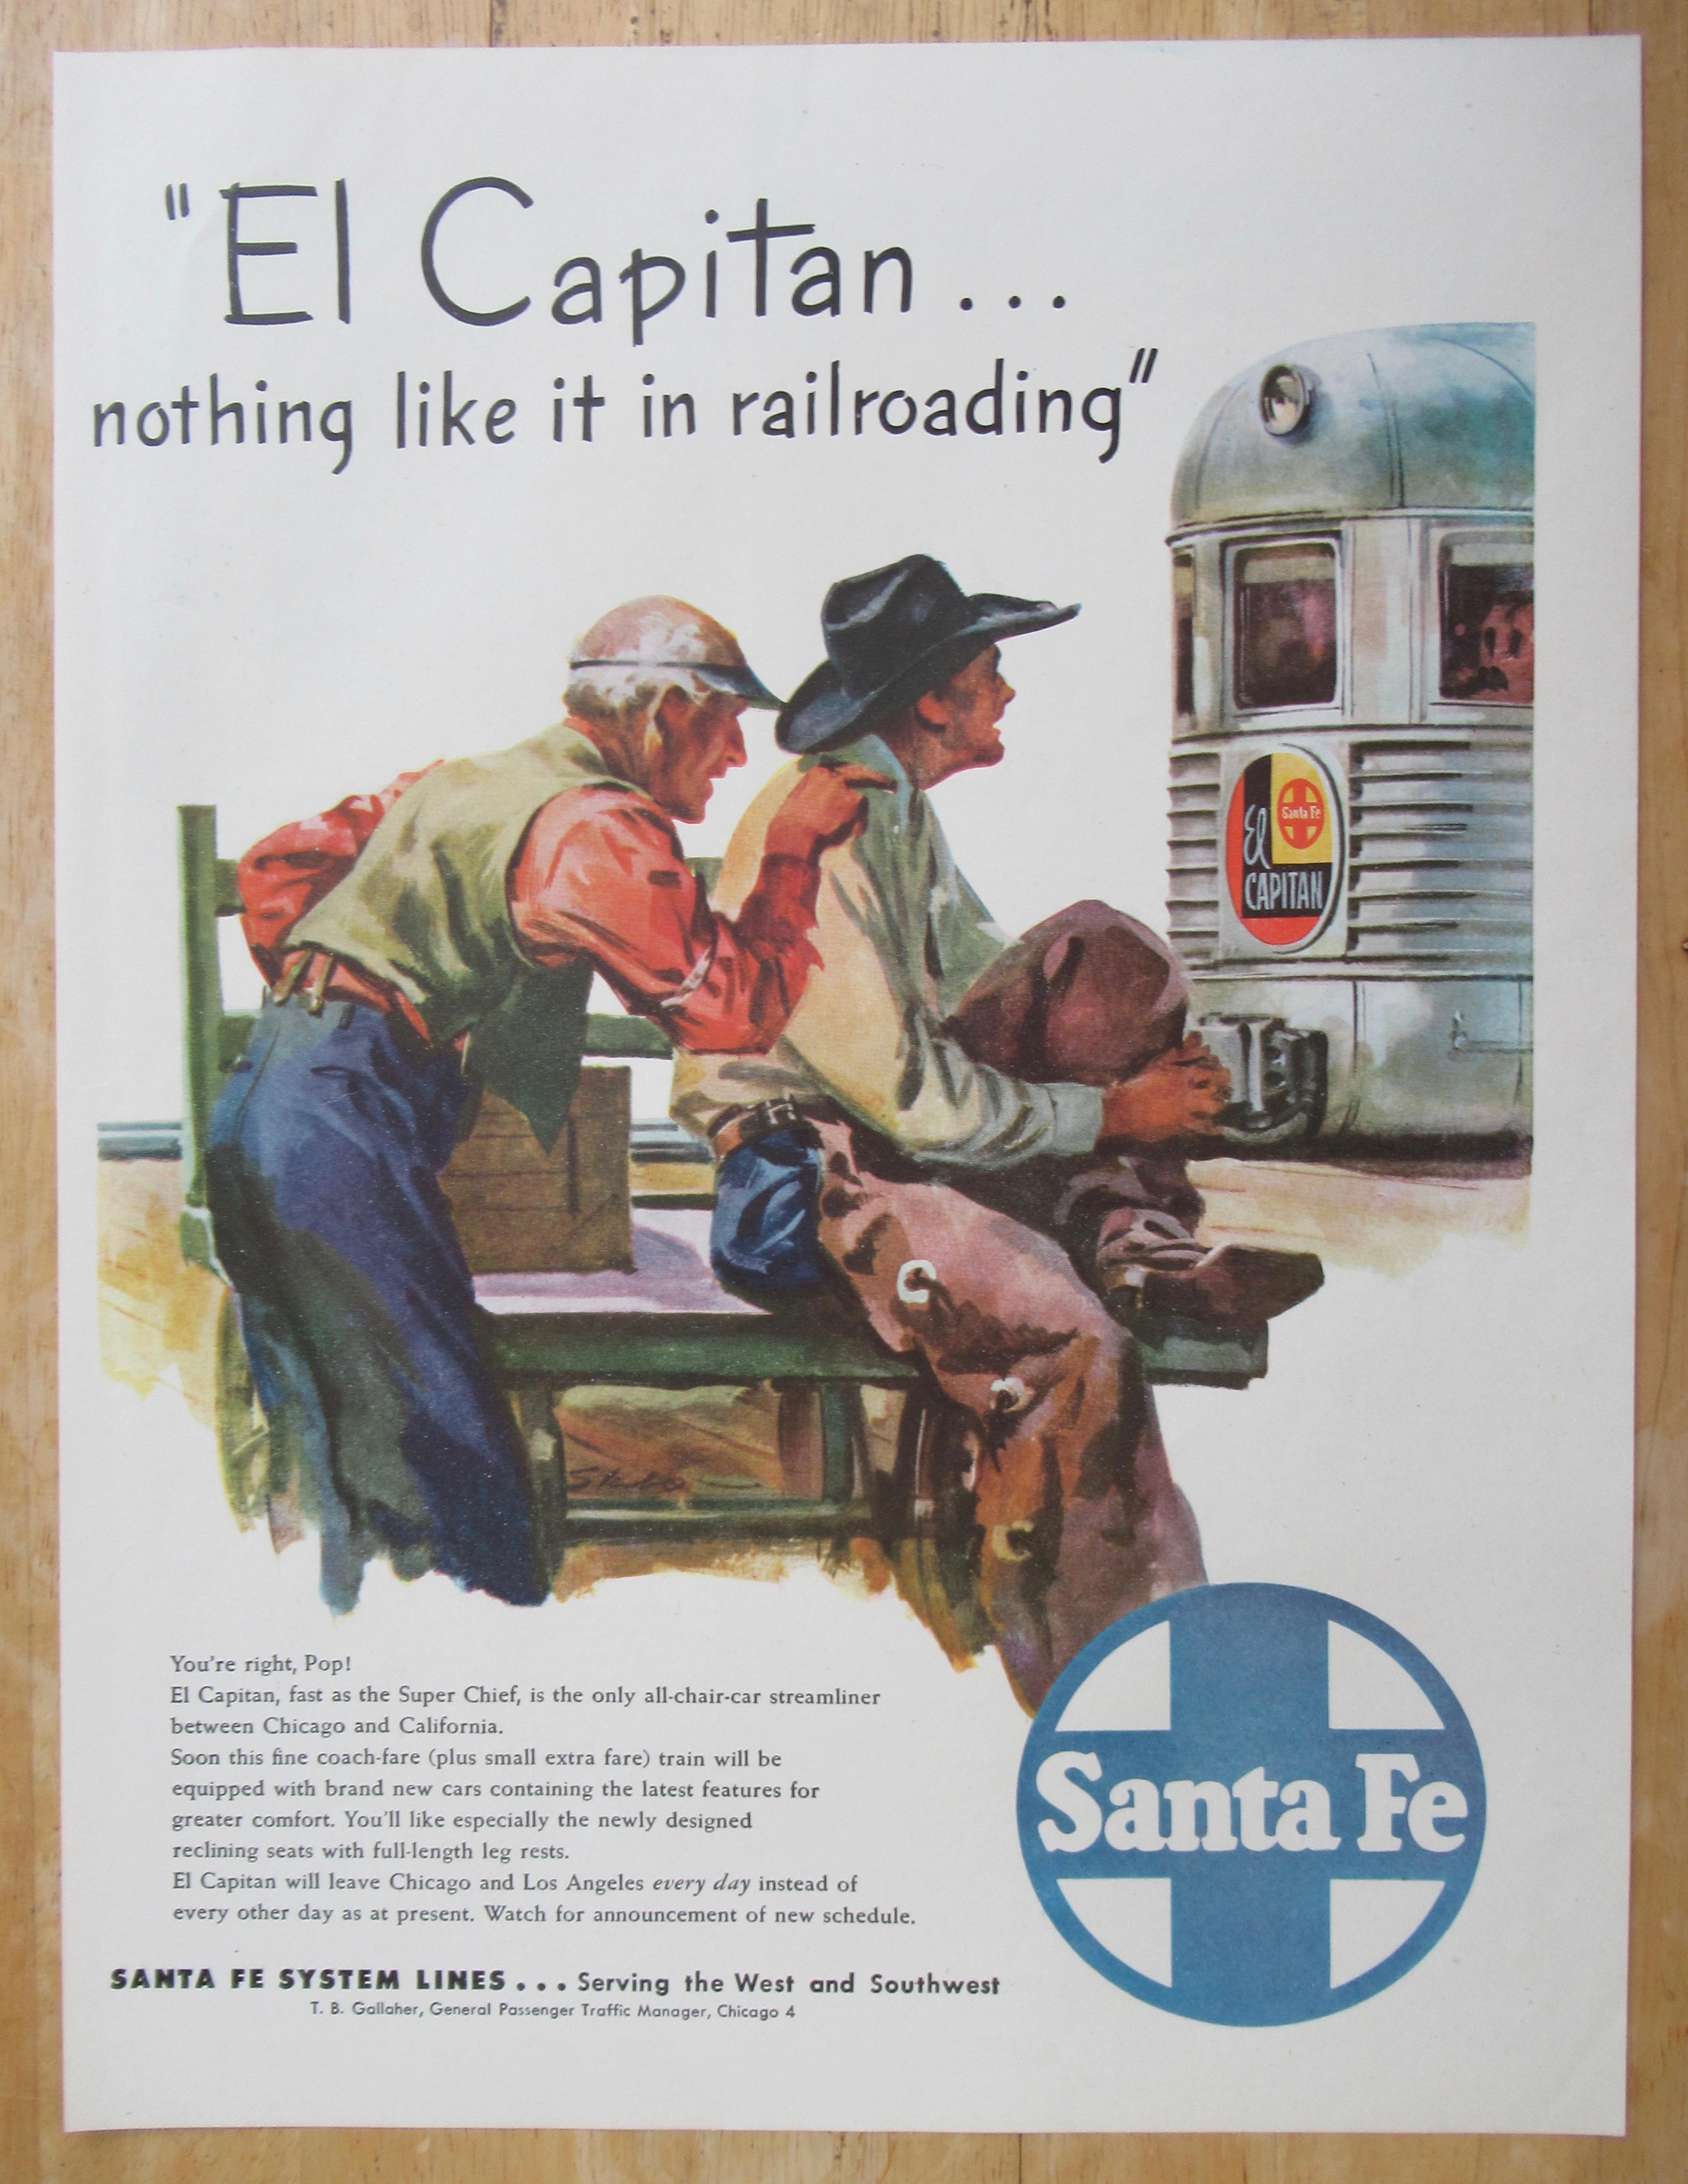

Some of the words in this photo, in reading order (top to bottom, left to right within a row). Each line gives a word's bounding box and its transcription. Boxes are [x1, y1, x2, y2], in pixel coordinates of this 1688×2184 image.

[164, 176, 351, 325] "El
[420, 175, 913, 347] Capitan
[94, 372, 353, 476] nothing
[396, 369, 516, 449] like
[552, 374, 606, 443] it
[642, 373, 697, 439] in
[732, 348, 1159, 464] railroading"
[1281, 806, 1308, 819] Santa
[1310, 805, 1321, 819] Fe
[1244, 804, 1271, 869] El
[1245, 871, 1322, 911] CAPITAN
[169, 1655, 236, 1673] You're
[245, 1654, 297, 1677] right,
[304, 1654, 351, 1676] Pop!
[170, 1686, 190, 1704] El
[197, 1685, 280, 1708] Capitan,
[289, 1684, 323, 1702] fast
[331, 1691, 351, 1702] as
[358, 1685, 390, 1702] the
[399, 1685, 456, 1708] Super
[463, 1685, 521, 1706] Chief,
[530, 1687, 545, 1703] is
[552, 1685, 583, 1703] the
[591, 1685, 636, 1708] only
[644, 1686, 762, 1704] all-chair-car
[769, 1687, 881, 1705] streamliner
[170, 1716, 254, 1734] between
[262, 1716, 346, 1739] Chicago
[354, 1716, 391, 1733] and
[399, 1716, 503, 1734] California.
[171, 1748, 220, 1766] Soon
[229, 1748, 264, 1765] this
[271, 1747, 308, 1765] fine
[317, 1747, 420, 1765] coach-fare
[428, 1748, 476, 1770] (plus
[484, 1748, 536, 1765] small
[545, 1751, 595, 1765] extra
[604, 1748, 650, 1768] fare)
[658, 1751, 705, 1766] train
[713, 1749, 749, 1767] will
[758, 1749, 782, 1767] be
[172, 1779, 265, 1801] equipped
[273, 1779, 316, 1797] with
[325, 1778, 385, 1797] brand
[392, 1784, 434, 1796] new
[442, 1784, 482, 1797] cars
[490, 1781, 594, 1801] containing
[601, 1779, 633, 1797] the
[642, 1780, 694, 1798] latest
[702, 1779, 782, 1798] features
[789, 1780, 820, 1799] for
[1036, 1750, 1341, 1853] Santa
[1355, 1752, 1468, 1853] Fe
[171, 1814, 243, 1832] greater
[252, 1810, 335, 1828] comfort.
[344, 1810, 400, 1828] You'll
[409, 1810, 445, 1828] like
[452, 1810, 549, 1833] especially
[557, 1810, 589, 1827] the
[598, 1810, 657, 1832] newly
[665, 1811, 753, 1833] designed
[172, 1840, 259, 1863] reclining
[266, 1845, 314, 1859] seats
[321, 1841, 365, 1859] with
[373, 1840, 474, 1864] full-length
[482, 1841, 512, 1864] leg
[520, 1845, 569, 1859] rests.
[172, 1871, 191, 1889] El
[200, 1872, 277, 1894] Capitan
[284, 1872, 320, 1889] will
[328, 1872, 380, 1890] leave
[389, 1872, 471, 1895] Chicago
[480, 1873, 515, 1891] and
[523, 1873, 557, 1891] Los
[565, 1873, 644, 1896] Angeles
[652, 1879, 706, 1897] every
[713, 1873, 751, 1897] day
[759, 1874, 829, 1892] instead
[836, 1874, 858, 1893] of
[172, 1908, 229, 1924] every
[237, 1903, 290, 1921] other
[298, 1903, 334, 1925] day
[342, 1909, 362, 1921] as
[369, 1907, 388, 1921] at
[396, 1907, 474, 1926] present.
[483, 1905, 547, 1922] Watch
[556, 1904, 585, 1922] for
[593, 1908, 737, 1922] announcement
[746, 1905, 767, 1923] of
[774, 1911, 815, 1923] new
[823, 1905, 916, 1925] schedule.
[110, 1968, 216, 1990] SANTA
[230, 1968, 264, 1989] FE
[278, 1968, 400, 1990] SYSTEM
[578, 1971, 669, 1996] Serving
[684, 1970, 724, 1993] the
[734, 1972, 795, 1993] West
[809, 1971, 855, 1994] and
[870, 1972, 1000, 1995] Southwest
[310, 2001, 324, 2014] T.
[330, 2001, 344, 2015] B.
[352, 2001, 424, 2018] Gallaher,
[429, 2001, 492, 2016] General
[499, 2002, 575, 2020] Passenger
[581, 2003, 631, 2017] Traffic
[637, 2004, 711, 2021] Manager,
[716, 2003, 779, 2021] Chicago
[785, 2004, 796, 2018] 4
